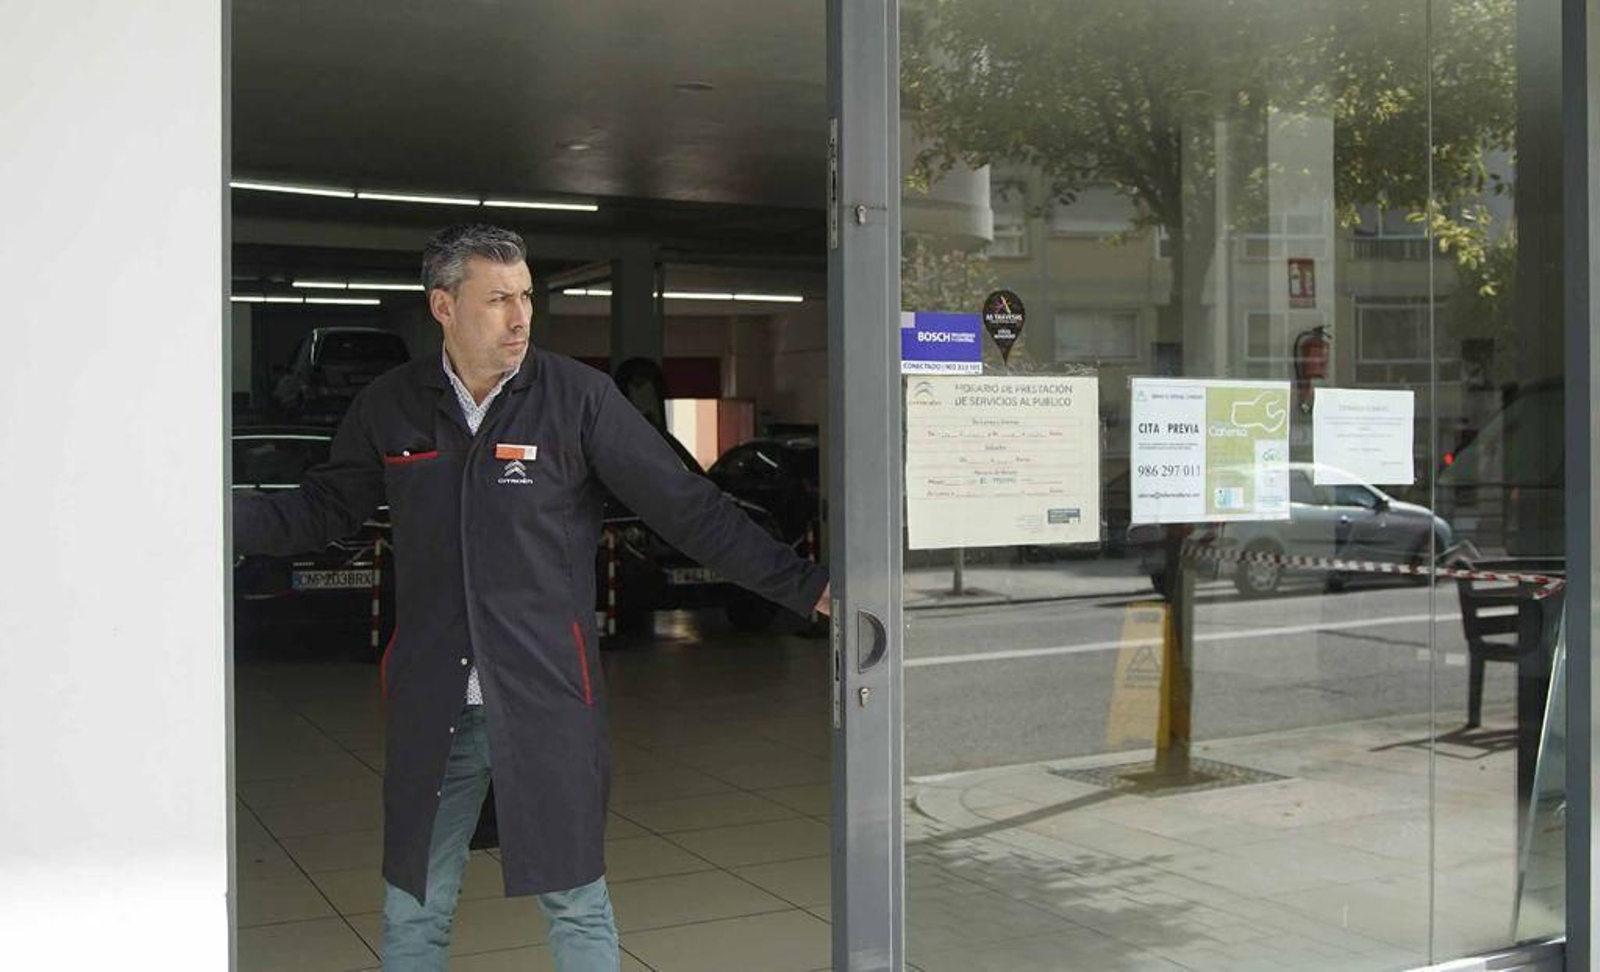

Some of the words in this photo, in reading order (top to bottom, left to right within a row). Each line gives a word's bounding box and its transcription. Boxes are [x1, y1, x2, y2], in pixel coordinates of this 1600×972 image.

[917, 331, 951, 343] BOSCH
[903, 362, 941, 370] CONECTADO
[955, 384, 999, 393] HORARIO
[1001, 385, 1013, 394] DE
[954, 397, 967, 407] DE
[969, 397, 1018, 407] SERVICIOS
[1019, 397, 1032, 407] AL
[1138, 422, 1160, 434] CITA
[1168, 422, 1200, 434] PREVIA
[1138, 464, 1158, 477] 986
[1161, 464, 1181, 477] 297
